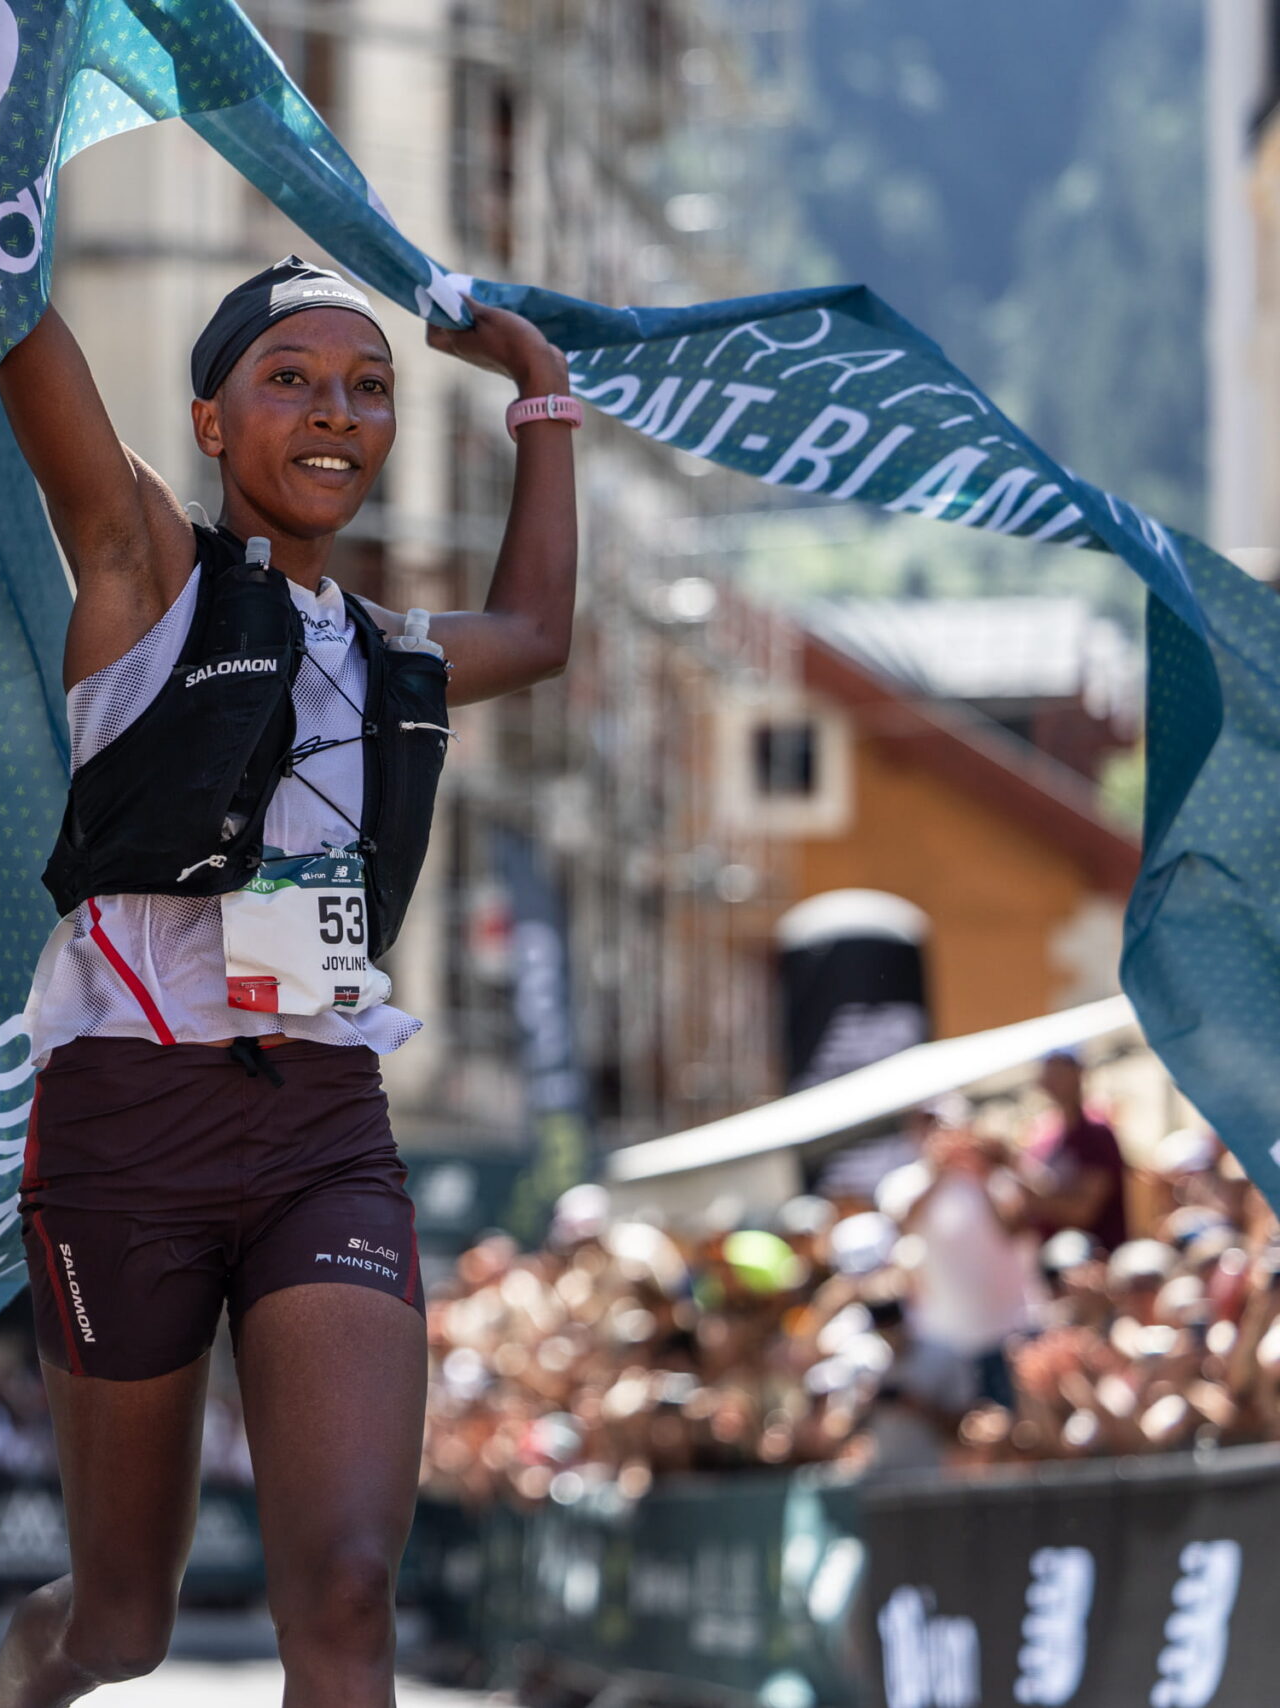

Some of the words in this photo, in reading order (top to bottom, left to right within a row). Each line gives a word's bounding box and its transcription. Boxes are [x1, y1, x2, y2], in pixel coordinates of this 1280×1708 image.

[185, 659, 277, 688] SALOMON
[319, 896, 364, 944] 53
[322, 956, 366, 971] JOYLINE
[249, 989, 255, 1001] 1
[337, 1255, 398, 1280] MNSTRY
[59, 1244, 96, 1342] SALOMON
